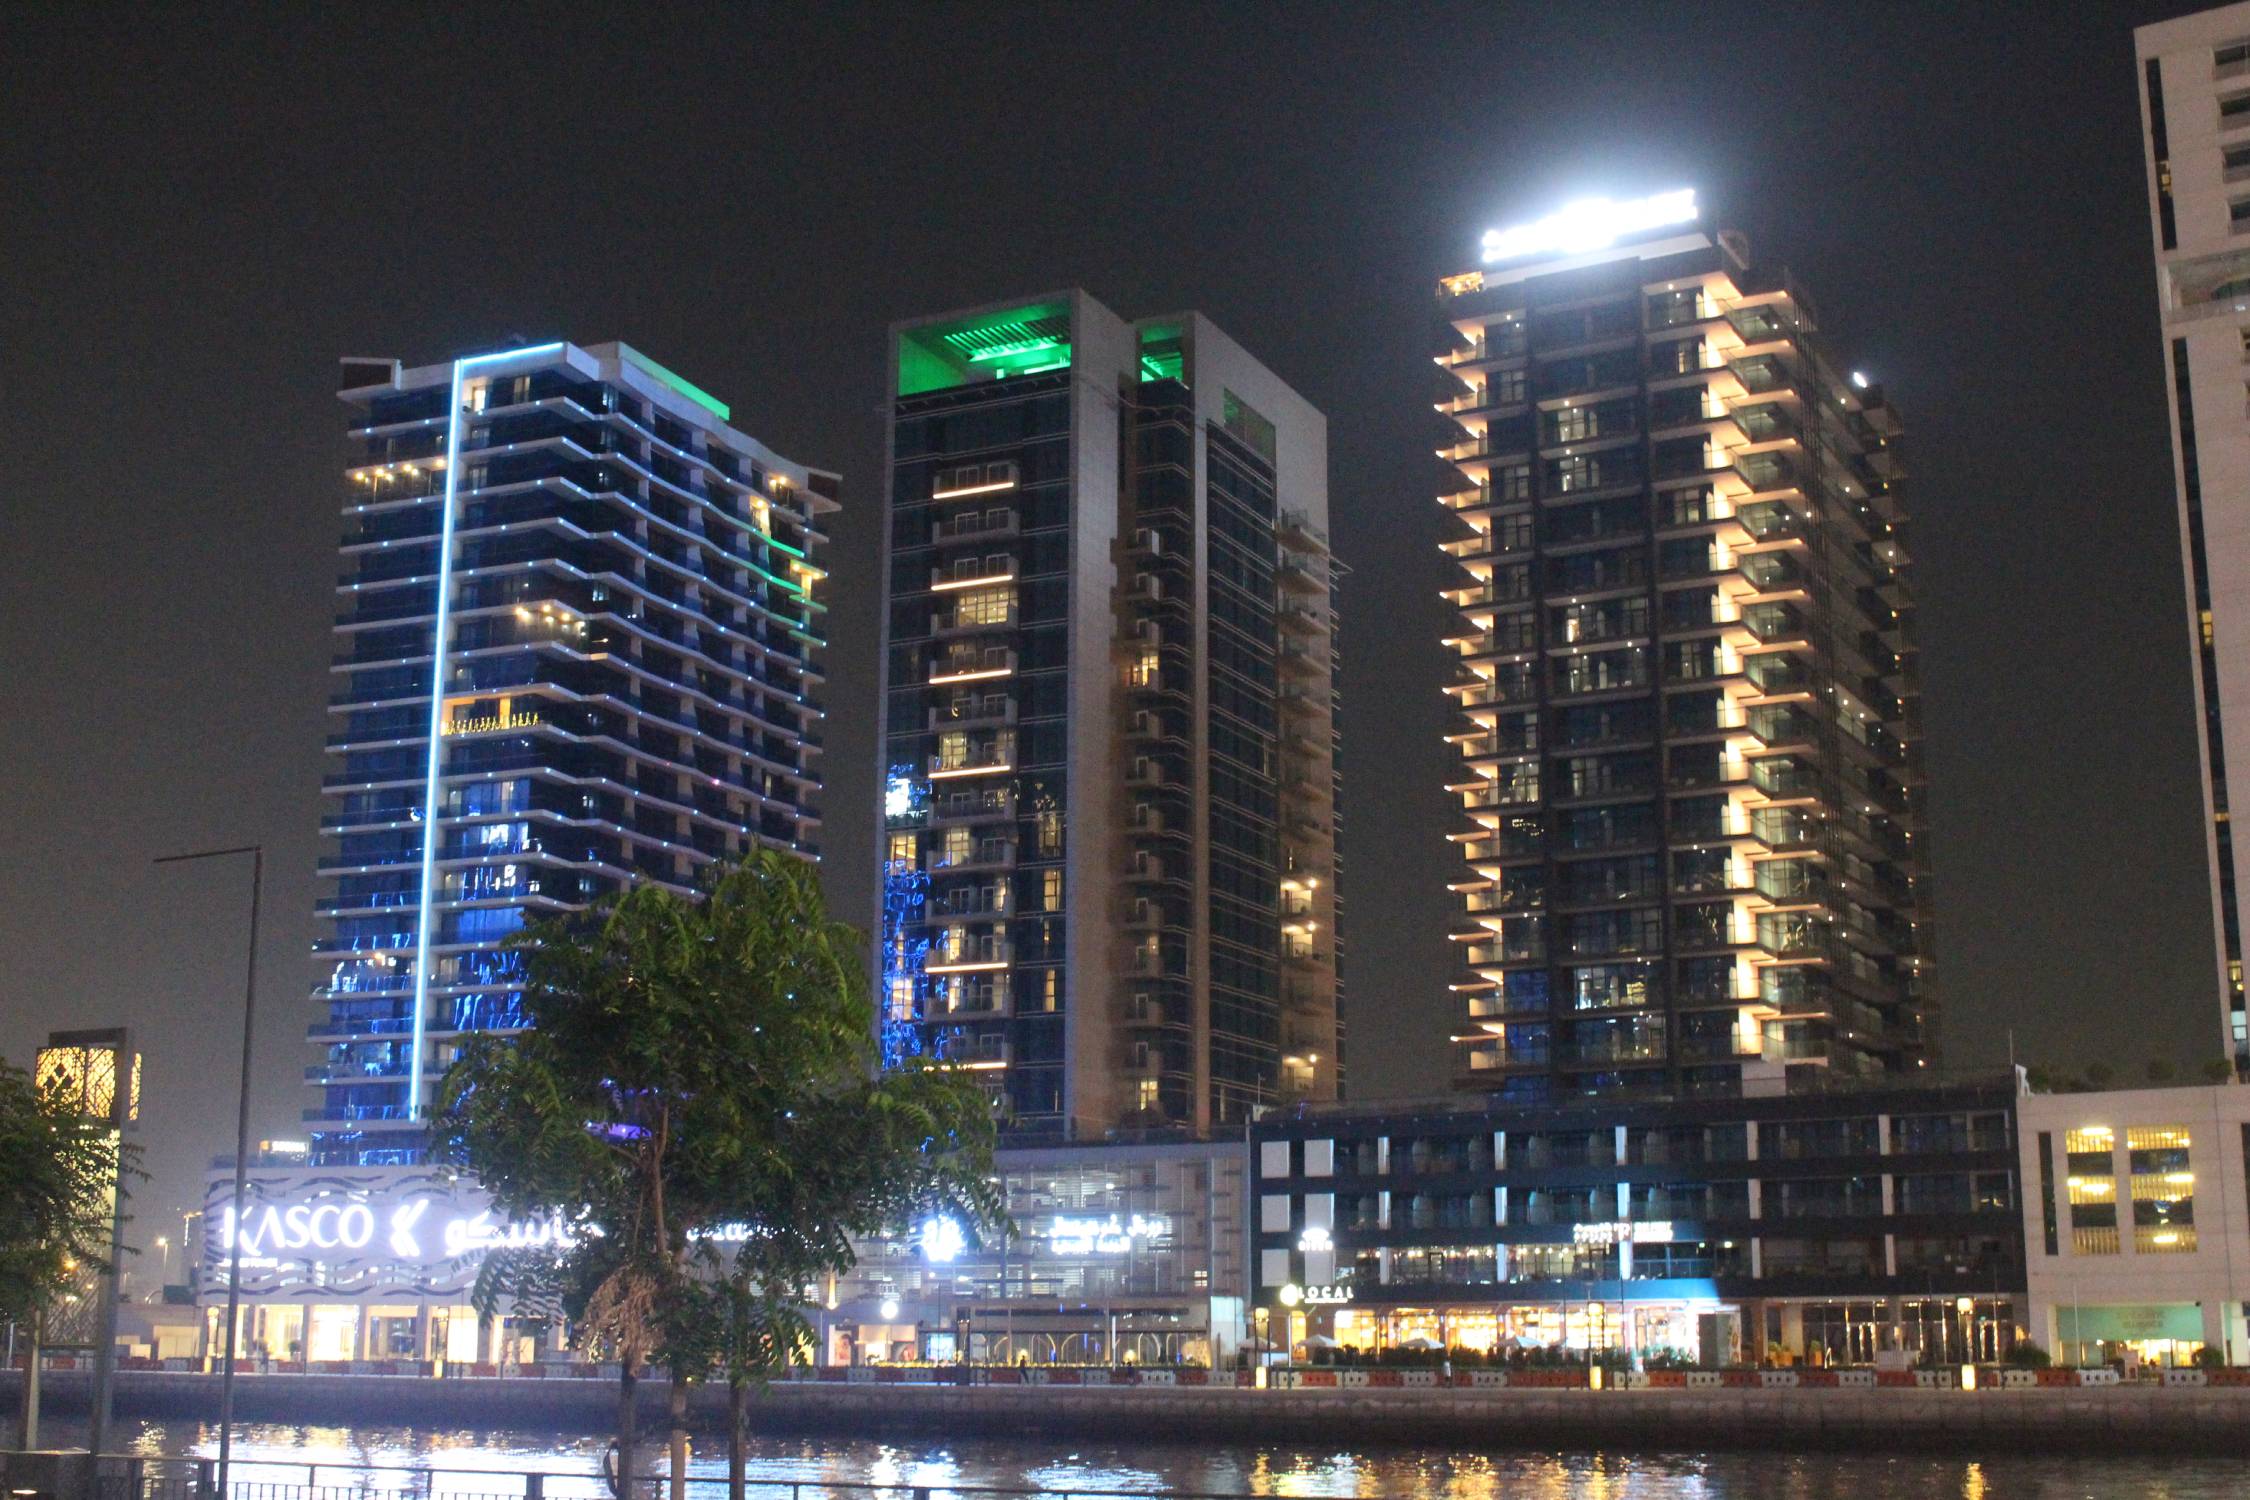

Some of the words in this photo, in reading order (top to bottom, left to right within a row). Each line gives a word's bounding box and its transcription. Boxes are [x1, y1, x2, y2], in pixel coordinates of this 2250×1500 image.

[223, 1203, 375, 1257] KASCO
[444, 1203, 605, 1257] اسكو
[1298, 1285, 1354, 1299] LOCAL
